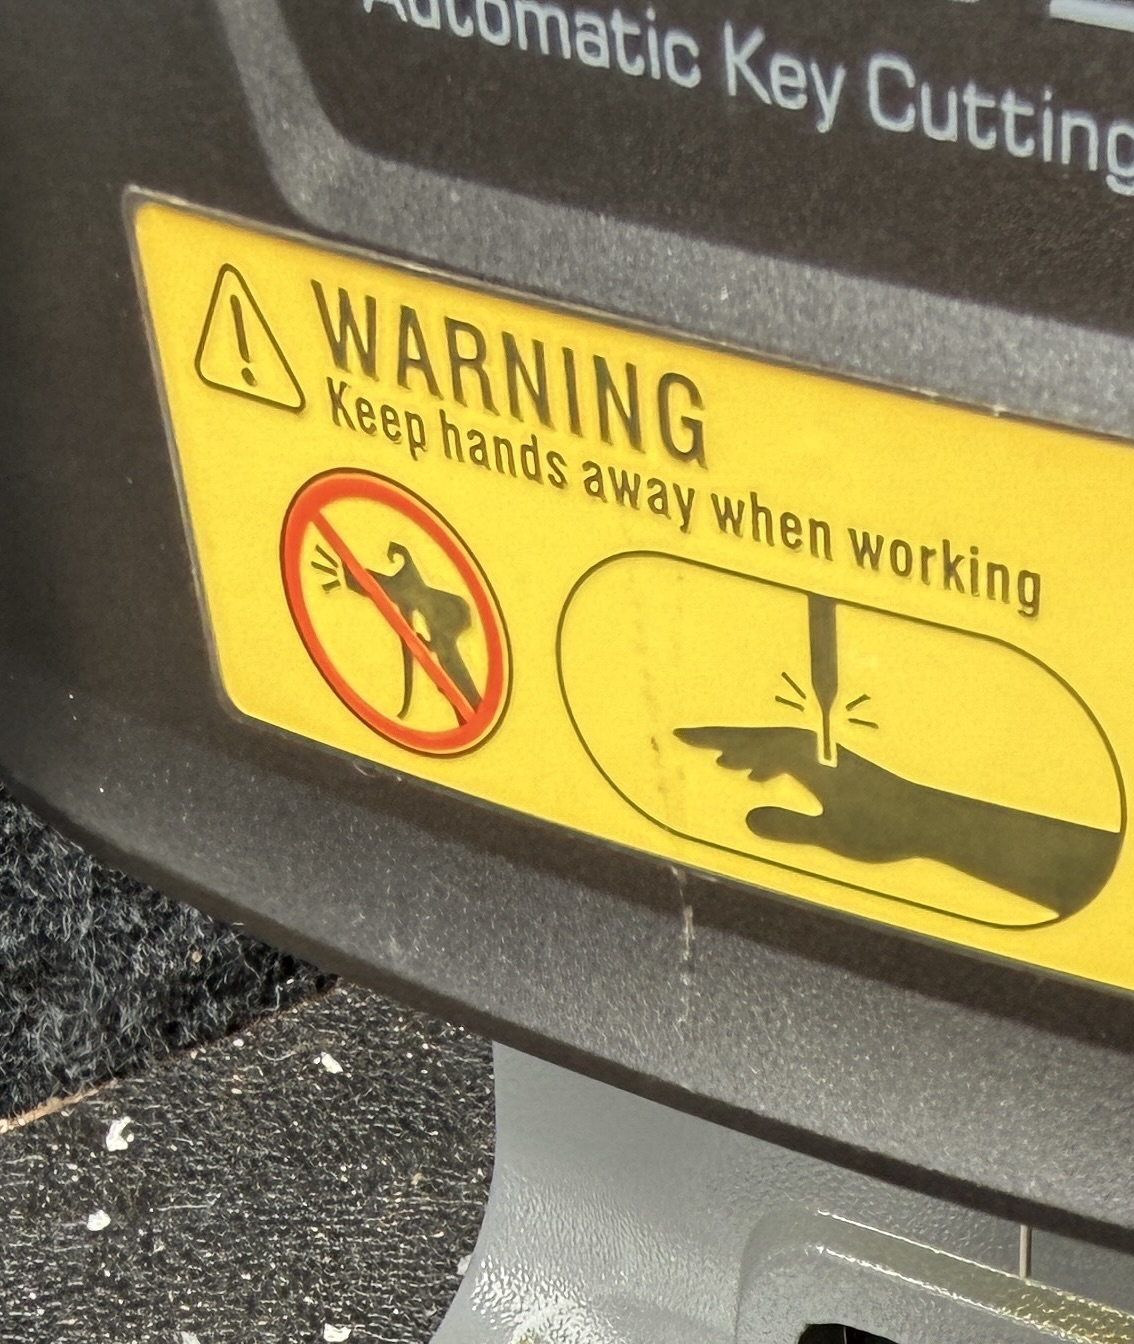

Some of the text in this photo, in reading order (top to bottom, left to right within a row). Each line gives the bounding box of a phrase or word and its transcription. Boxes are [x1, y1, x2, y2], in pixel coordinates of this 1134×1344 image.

[363, 0, 701, 89] utomatic
[723, 20, 847, 134] Key
[311, 279, 709, 469] WARNING
[326, 376, 1042, 619] Keep hands away when working
